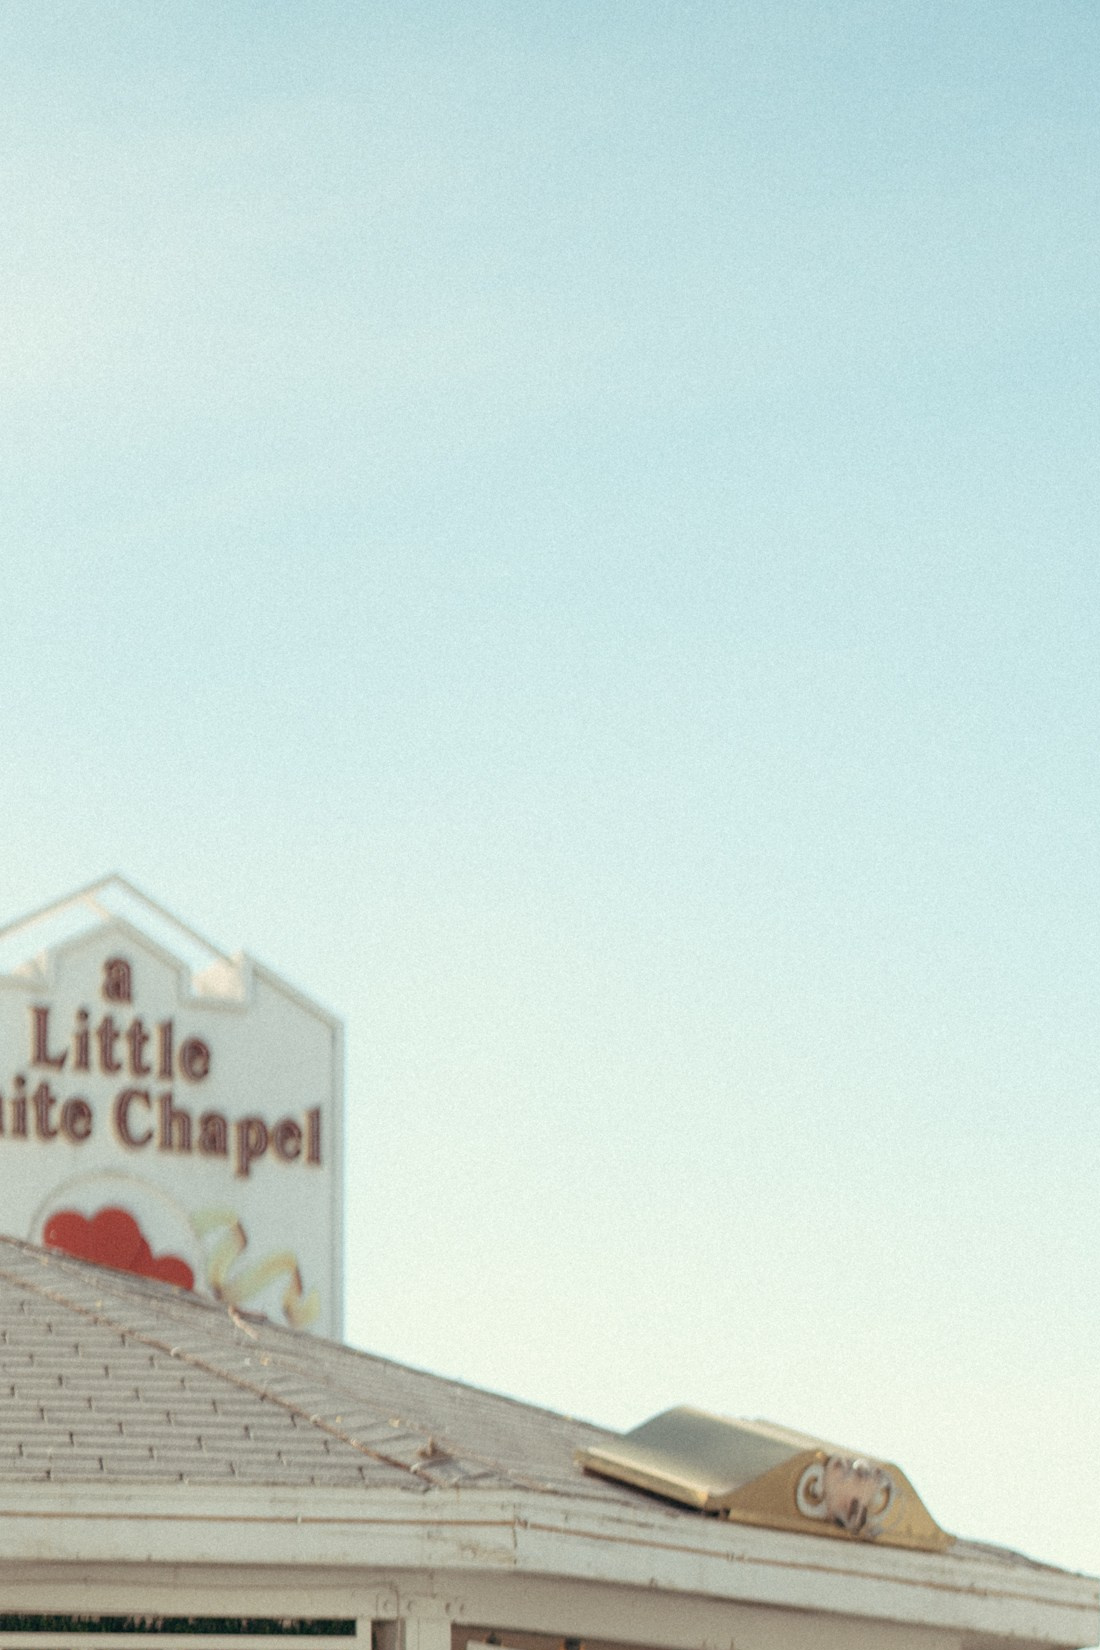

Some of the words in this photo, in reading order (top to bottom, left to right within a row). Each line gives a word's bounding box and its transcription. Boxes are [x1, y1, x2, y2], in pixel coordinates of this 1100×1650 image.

[103, 956, 132, 1004] a
[31, 1005, 211, 1082] Little
[0, 1074, 93, 1143] ite
[114, 1089, 322, 1178] Chapel
